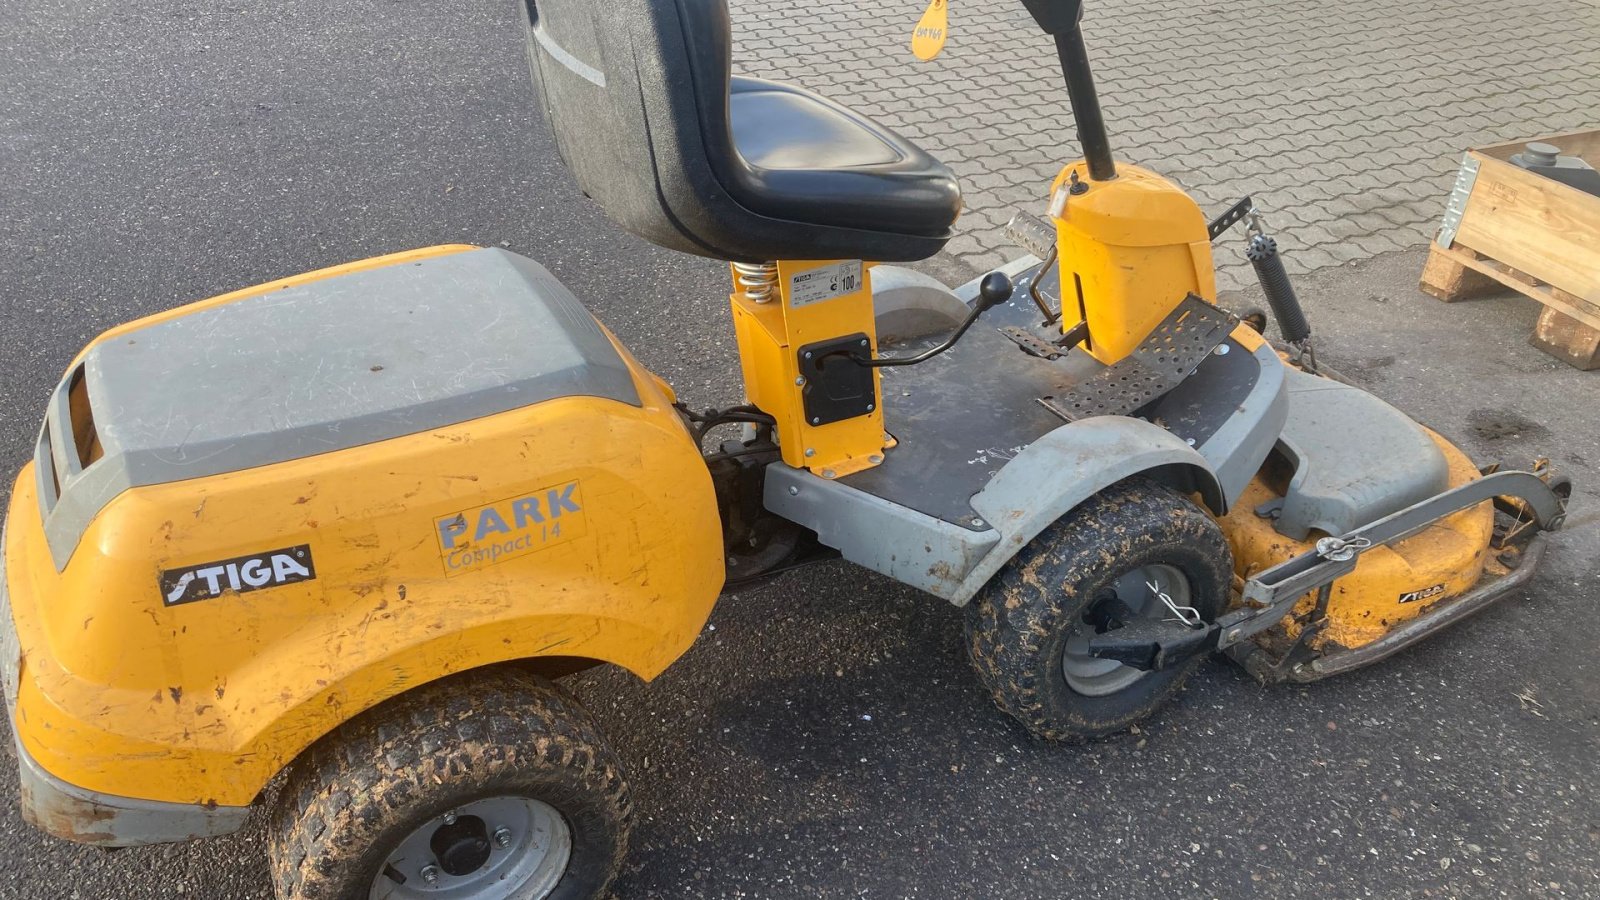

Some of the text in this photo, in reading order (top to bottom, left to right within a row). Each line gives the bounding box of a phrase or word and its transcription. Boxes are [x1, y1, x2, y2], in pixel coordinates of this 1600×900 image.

[842, 275, 855, 291] 100
[438, 483, 581, 549] PARK
[447, 521, 561, 569] Compact 14
